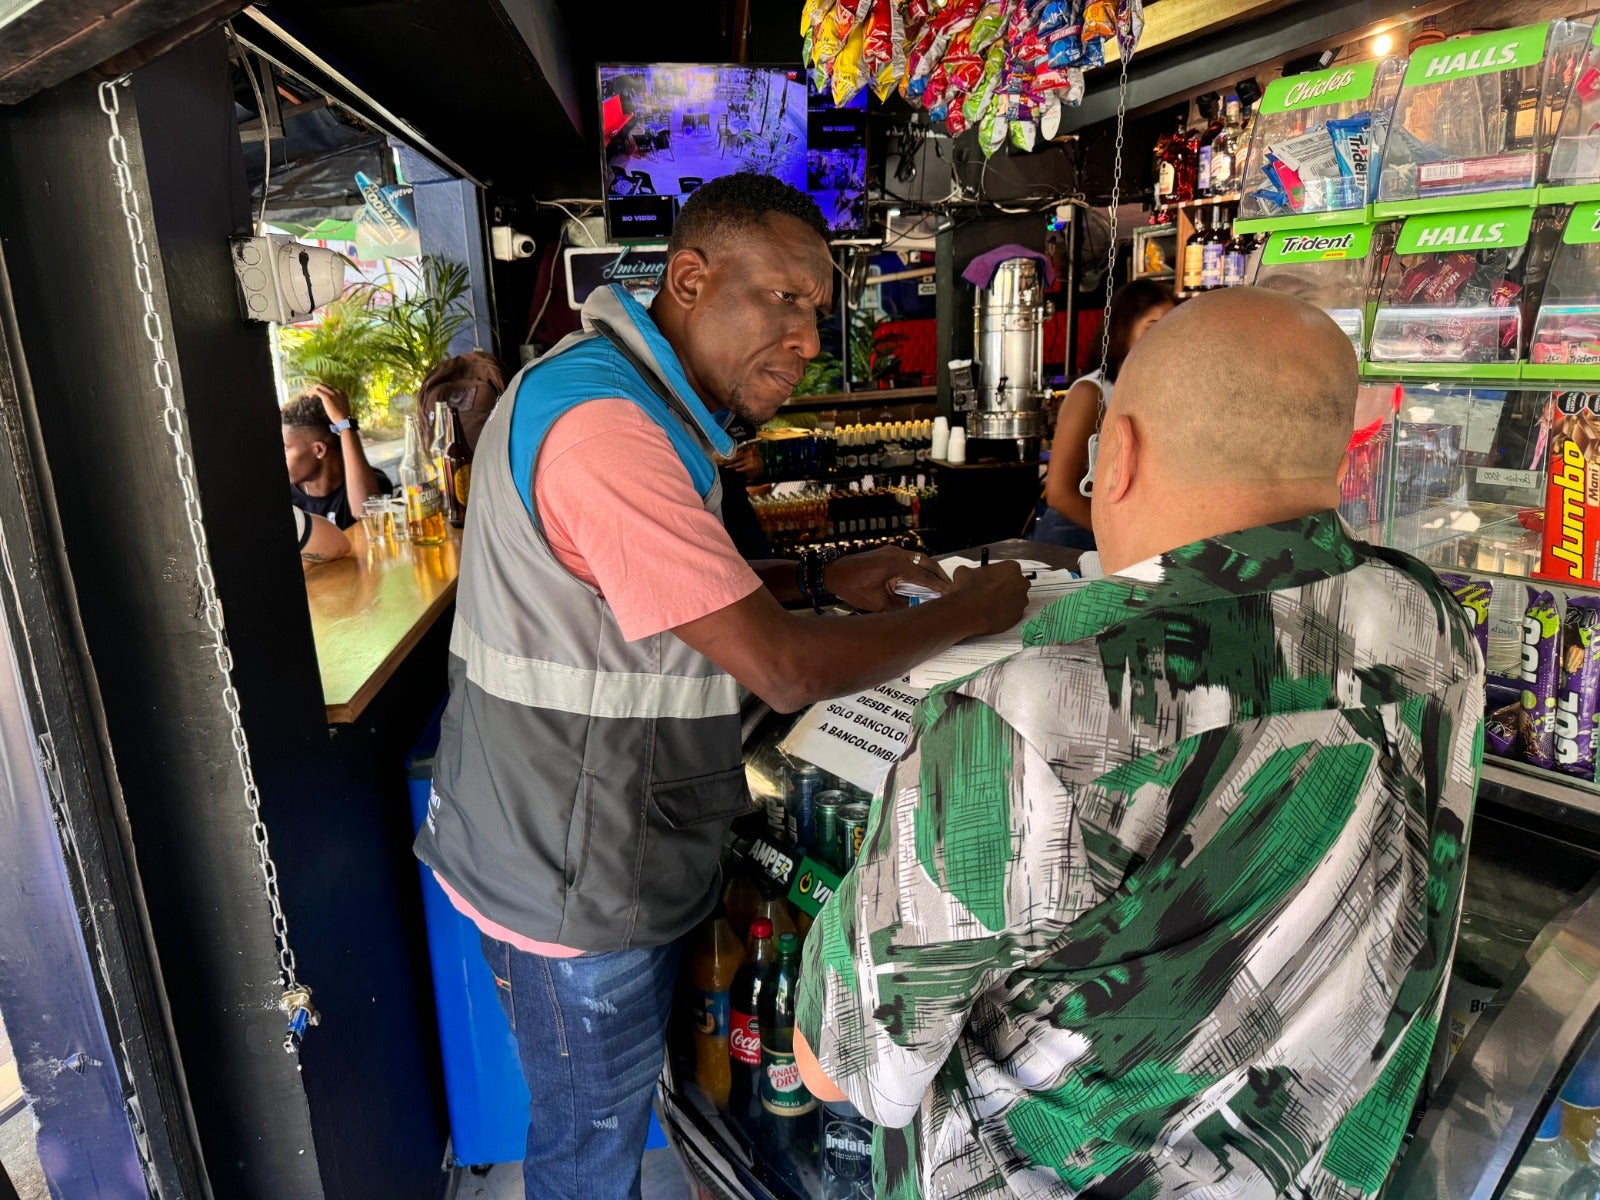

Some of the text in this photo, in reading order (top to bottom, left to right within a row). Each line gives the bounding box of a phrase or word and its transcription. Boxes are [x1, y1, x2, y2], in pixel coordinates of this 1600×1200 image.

[1425, 43, 1519, 78] HALLS
[1284, 70, 1355, 107] Chiclets
[1281, 233, 1354, 254] Trident
[1416, 223, 1505, 248] HALLS
[1552, 439, 1585, 579] Jumbo
[827, 704, 854, 719] SOLO
[856, 695, 892, 715] DESDE
[819, 722, 829, 732] A
[1544, 709, 1555, 733] GOL
[1554, 691, 1579, 764] GOL
[748, 839, 793, 882] AMPER
[731, 1028, 761, 1056] Coca
[776, 1073, 799, 1088] DRY
[826, 1134, 872, 1156] Bretaña
